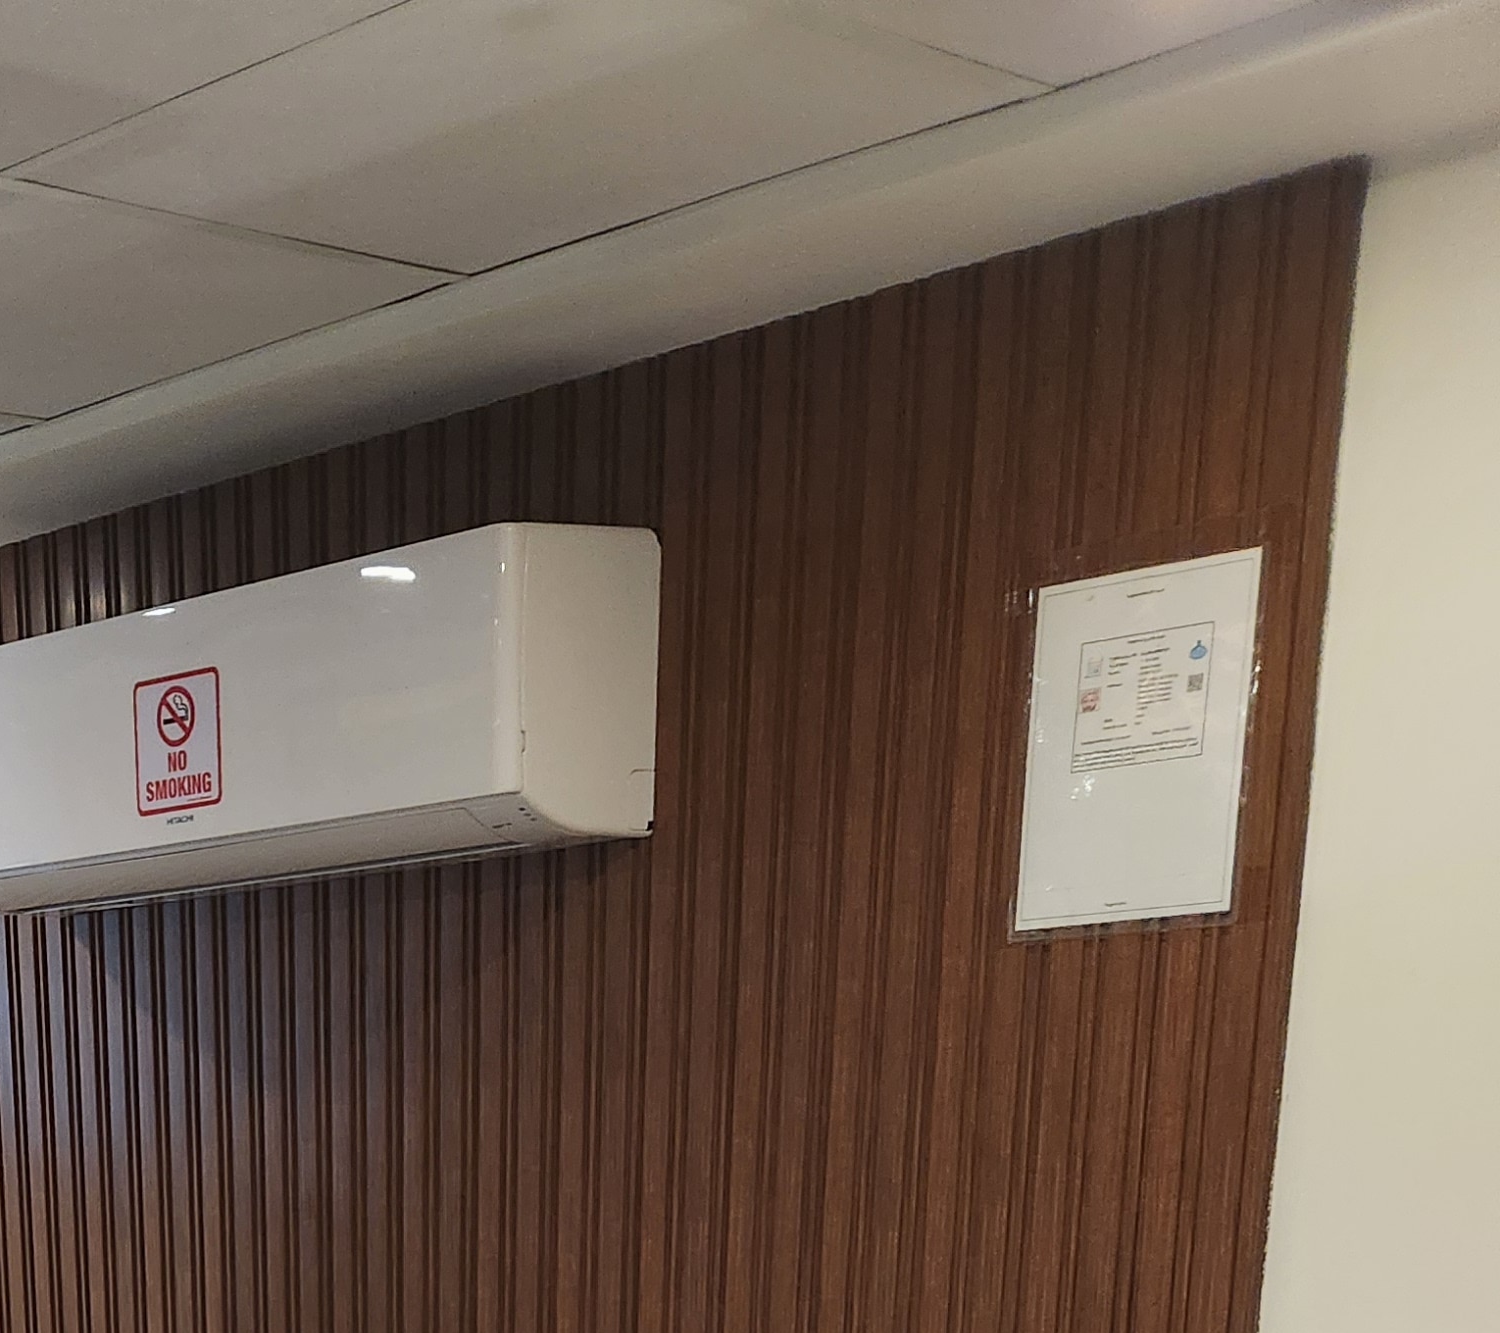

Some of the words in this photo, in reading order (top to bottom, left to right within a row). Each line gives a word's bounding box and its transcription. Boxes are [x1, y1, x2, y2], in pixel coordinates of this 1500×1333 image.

[168, 751, 187, 772] NO
[147, 772, 211, 802] SMOKING
[167, 815, 194, 825] HITACHI
